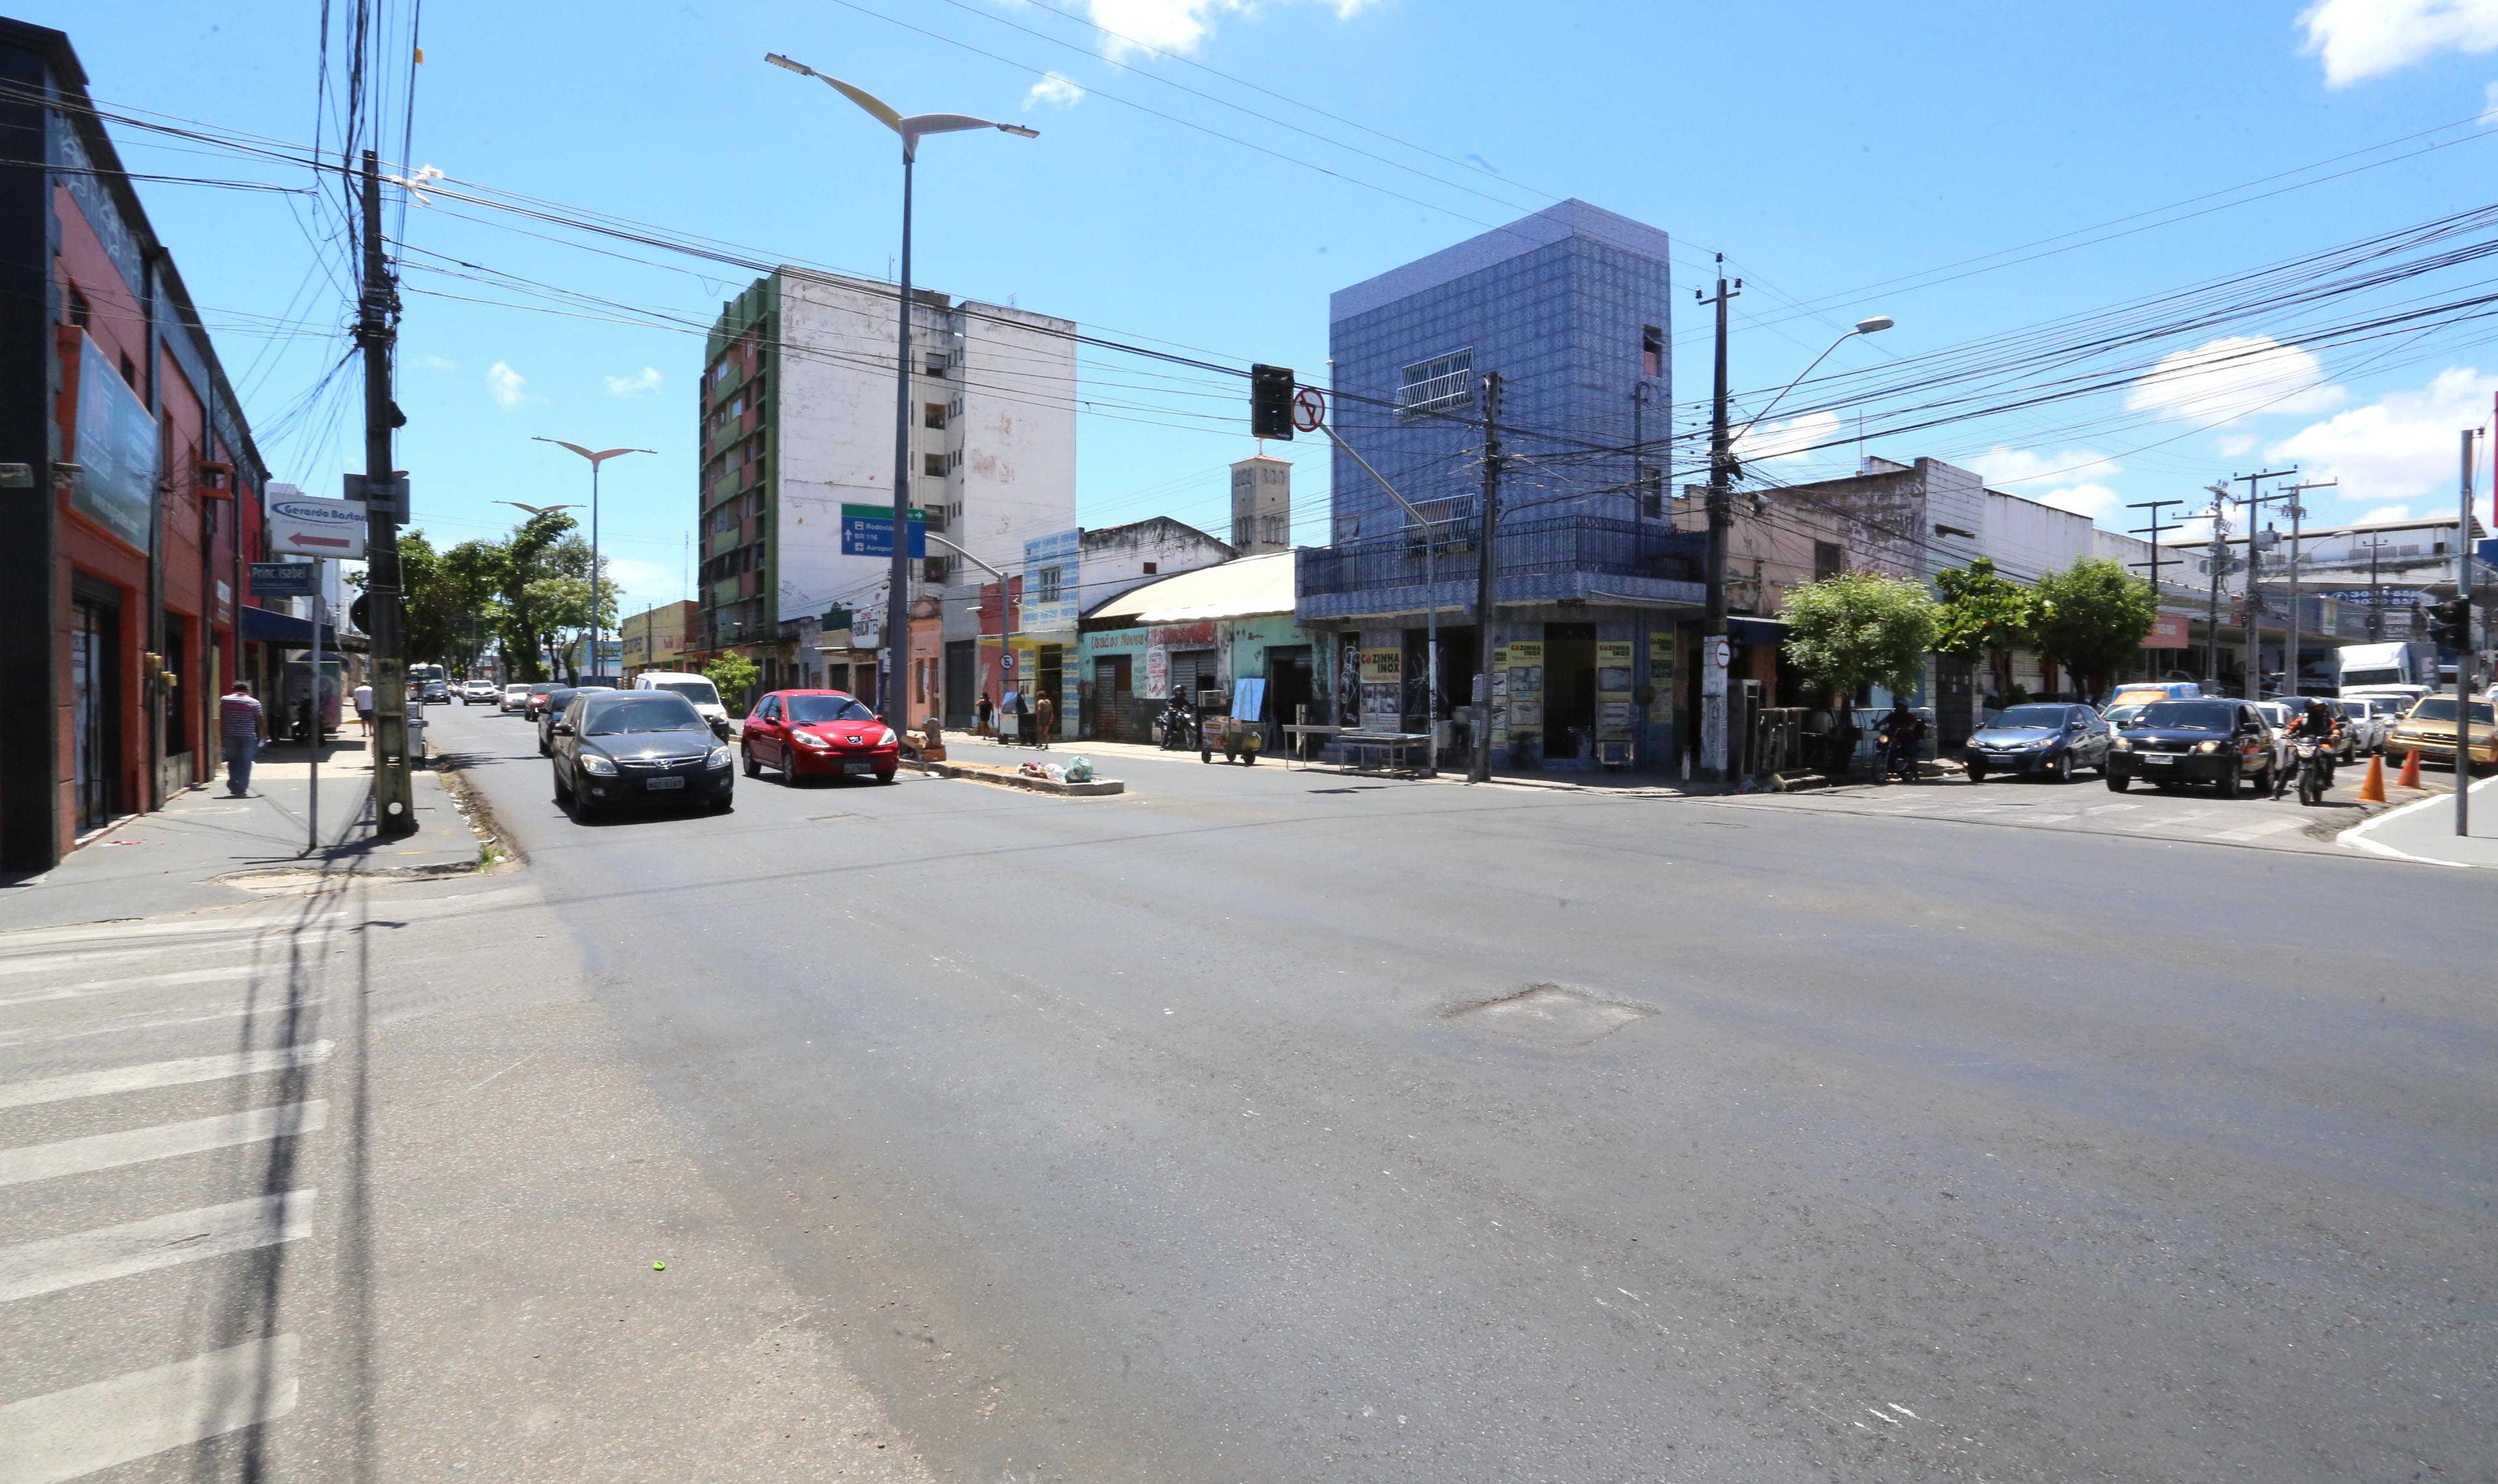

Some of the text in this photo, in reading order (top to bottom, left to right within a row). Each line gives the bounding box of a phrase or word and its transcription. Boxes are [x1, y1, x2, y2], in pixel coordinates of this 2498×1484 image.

[284, 505, 366, 521] Gerardo Bastos
[278, 567, 306, 579] Isabel
[1092, 634, 1118, 650] Usados
[1121, 633, 1144, 646] Novos
[1361, 653, 1401, 664] COZINHA
[1377, 663, 1400, 673] INOX
